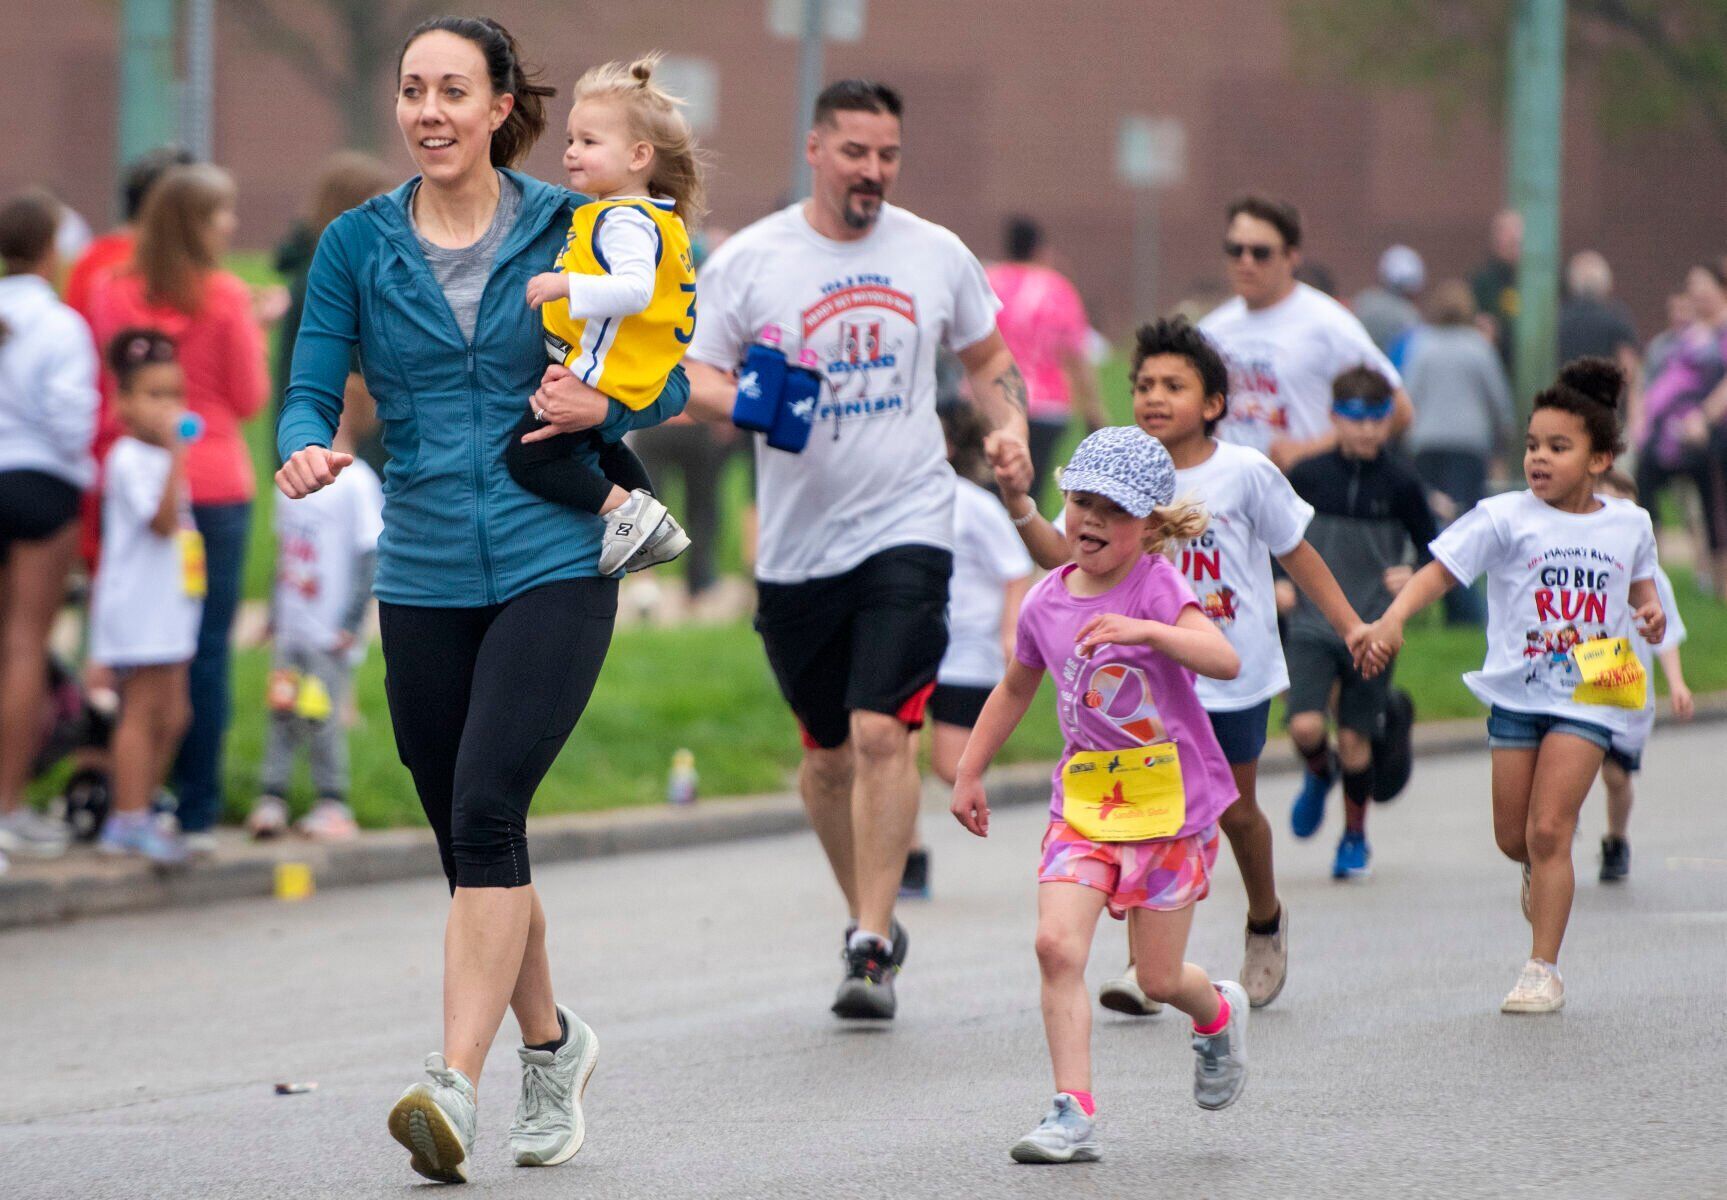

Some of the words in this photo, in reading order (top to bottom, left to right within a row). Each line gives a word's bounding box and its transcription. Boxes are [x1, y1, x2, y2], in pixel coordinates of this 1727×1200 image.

[821, 396, 901, 418] FINISH
[1543, 546, 1587, 560] MAYOR'S
[1540, 566, 1569, 587] GO
[1573, 566, 1609, 590] BIG
[1535, 589, 1607, 623] RUN
